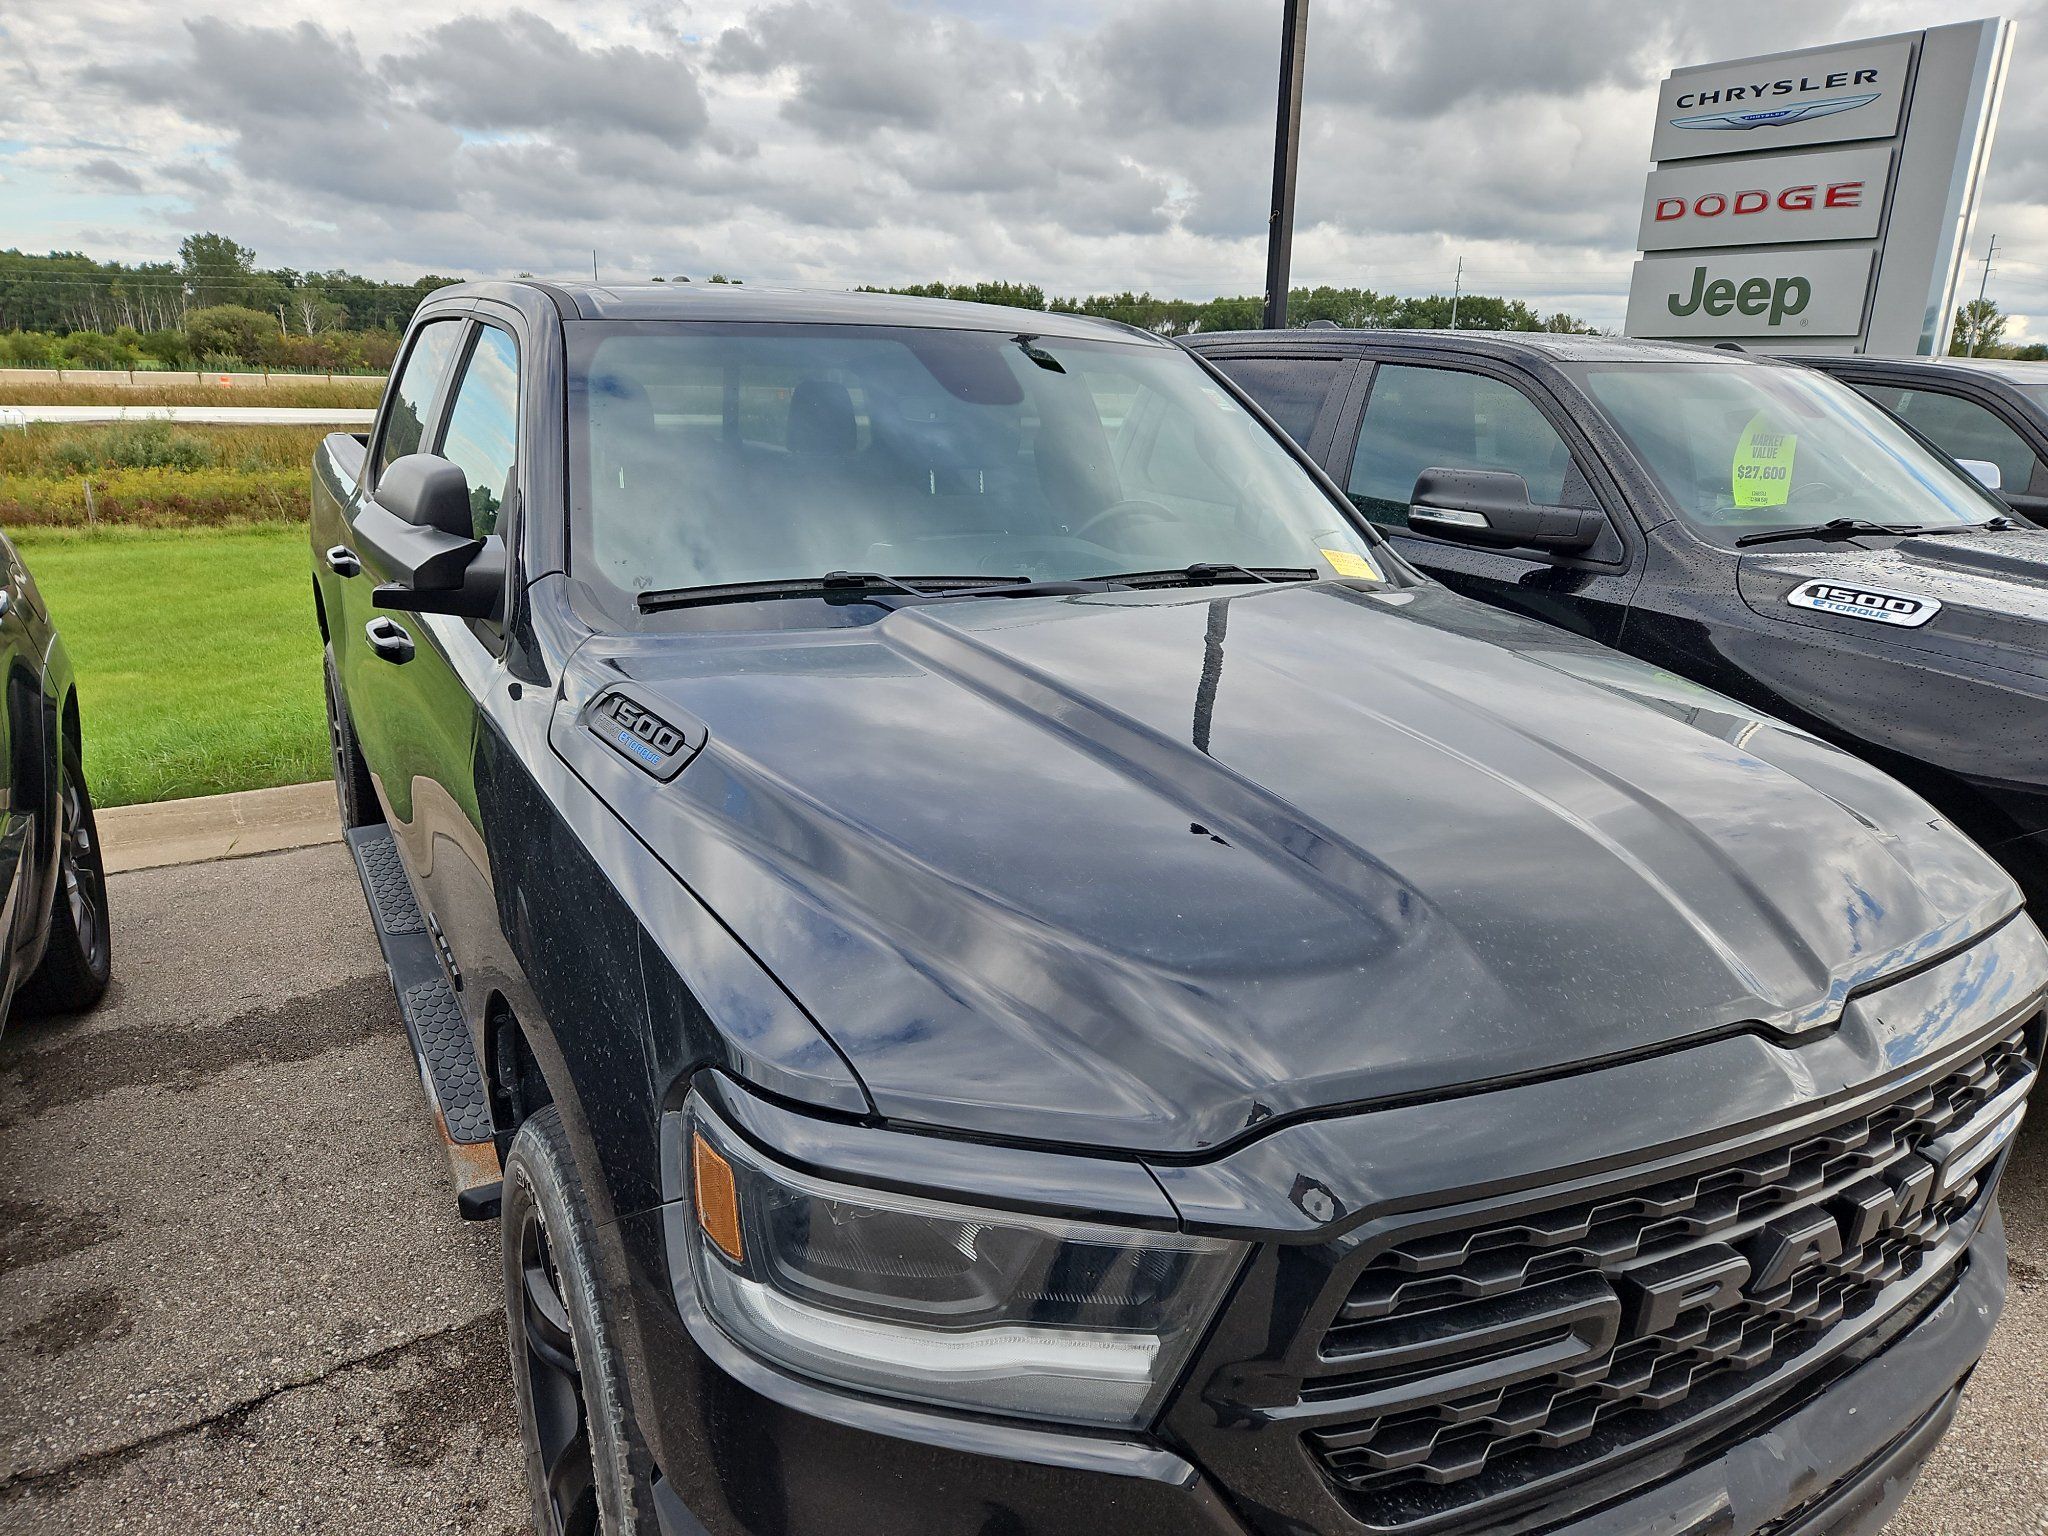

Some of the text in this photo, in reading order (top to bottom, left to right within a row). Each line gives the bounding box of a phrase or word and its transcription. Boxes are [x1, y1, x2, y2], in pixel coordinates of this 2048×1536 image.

[1676, 69, 1878, 108] CHRYSLER
[1655, 181, 1866, 222] DODGE
[1667, 267, 1811, 326] Jeep
[1750, 433, 1784, 447] MARKET
[1752, 446, 1778, 459] VALUE
[1737, 464, 1787, 480] $27,600
[1816, 586, 1914, 613] 1500
[609, 697, 682, 755] 1500
[1625, 1153, 1935, 1338] RAM
